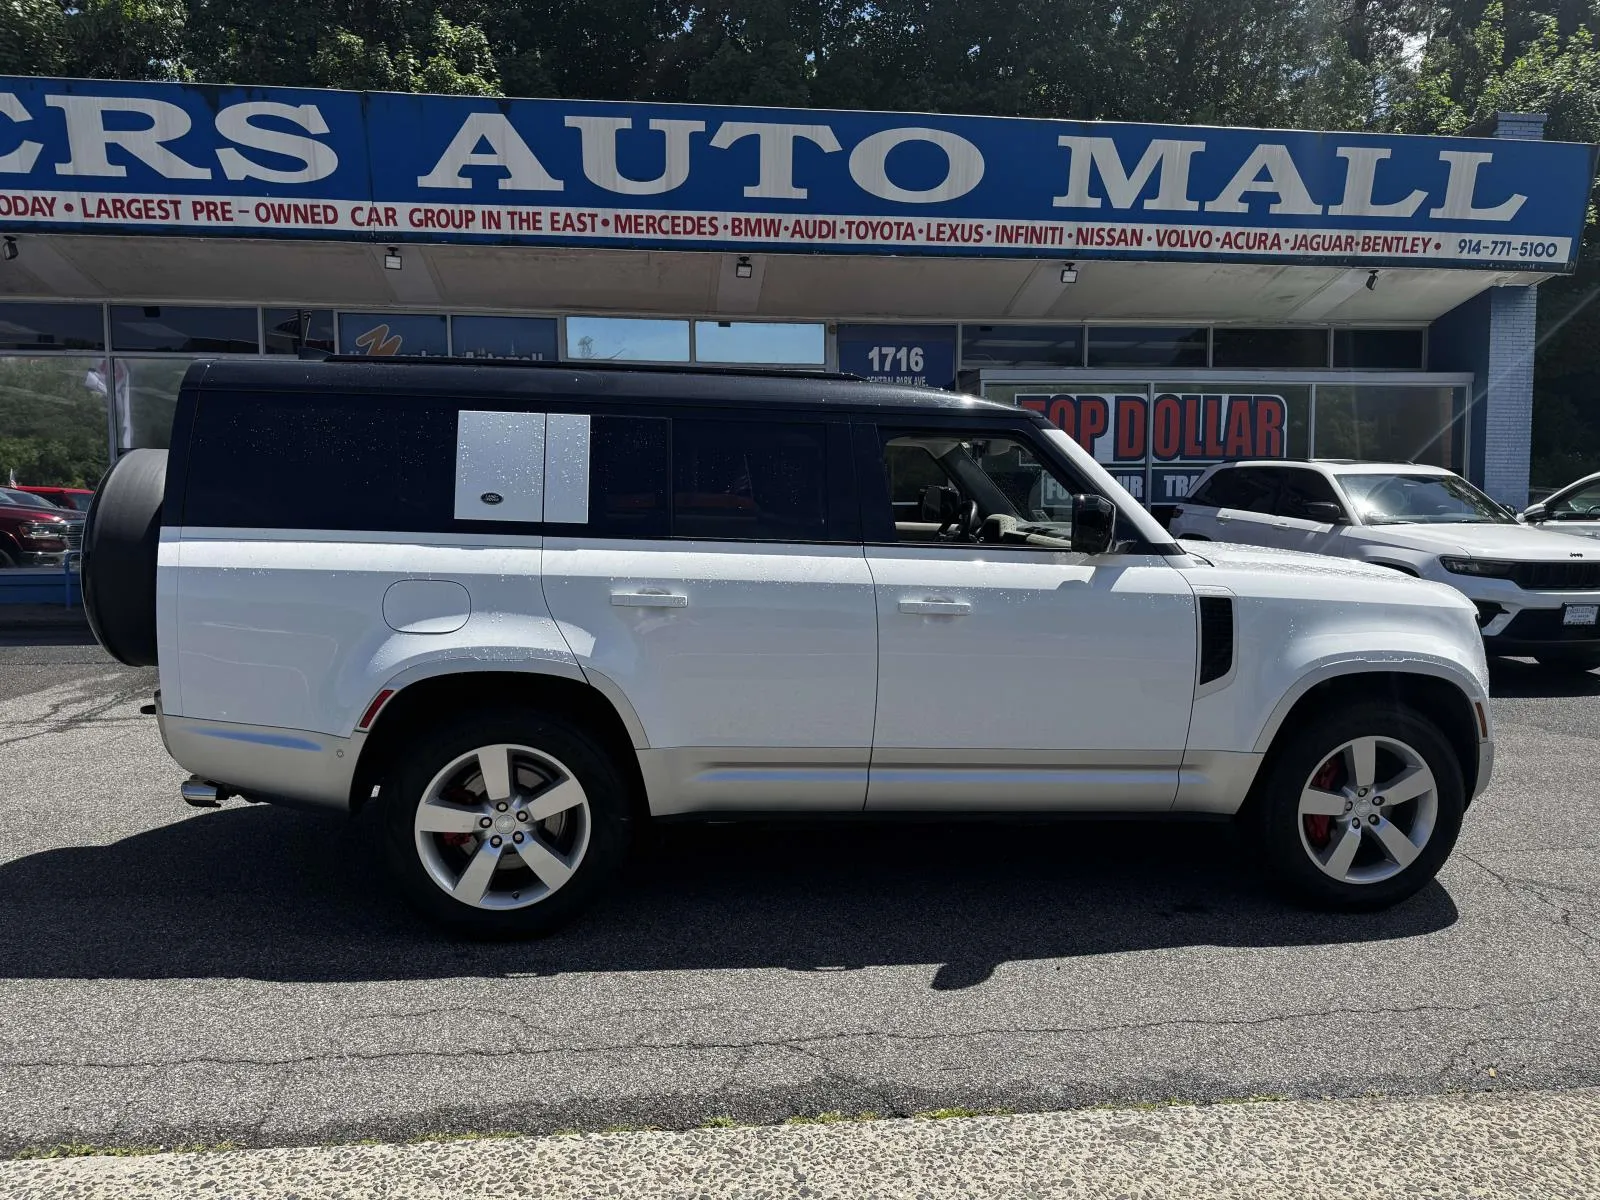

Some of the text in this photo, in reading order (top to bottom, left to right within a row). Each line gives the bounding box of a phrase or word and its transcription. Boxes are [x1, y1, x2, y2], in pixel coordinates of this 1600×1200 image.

[417, 112, 986, 204] AUTO
[1052, 134, 1529, 222] MALL
[82, 197, 182, 221] LARGEST
[350, 207, 399, 227] CAR
[408, 207, 476, 230] GROUP
[481, 210, 502, 230] IN
[508, 210, 543, 232] THE
[550, 211, 598, 233] EAST
[614, 213, 719, 236] MERCEDES
[731, 217, 782, 238] BMW
[790, 219, 837, 240] AUDI
[844, 220, 915, 242] TOYOTA
[926, 223, 984, 243] LEXUS
[995, 225, 1064, 245] INFINITI
[1075, 227, 1143, 247] NISSAN
[1156, 230, 1213, 249] VOLVO
[1220, 231, 1282, 251] ACURA
[1289, 234, 1354, 253] JAGUAR
[1361, 236, 1430, 255] BENTLEY
[1457, 237, 1558, 259] 914-771-5100
[868, 346, 924, 372] 1716
[1116, 397, 1284, 459] DOLLAR
